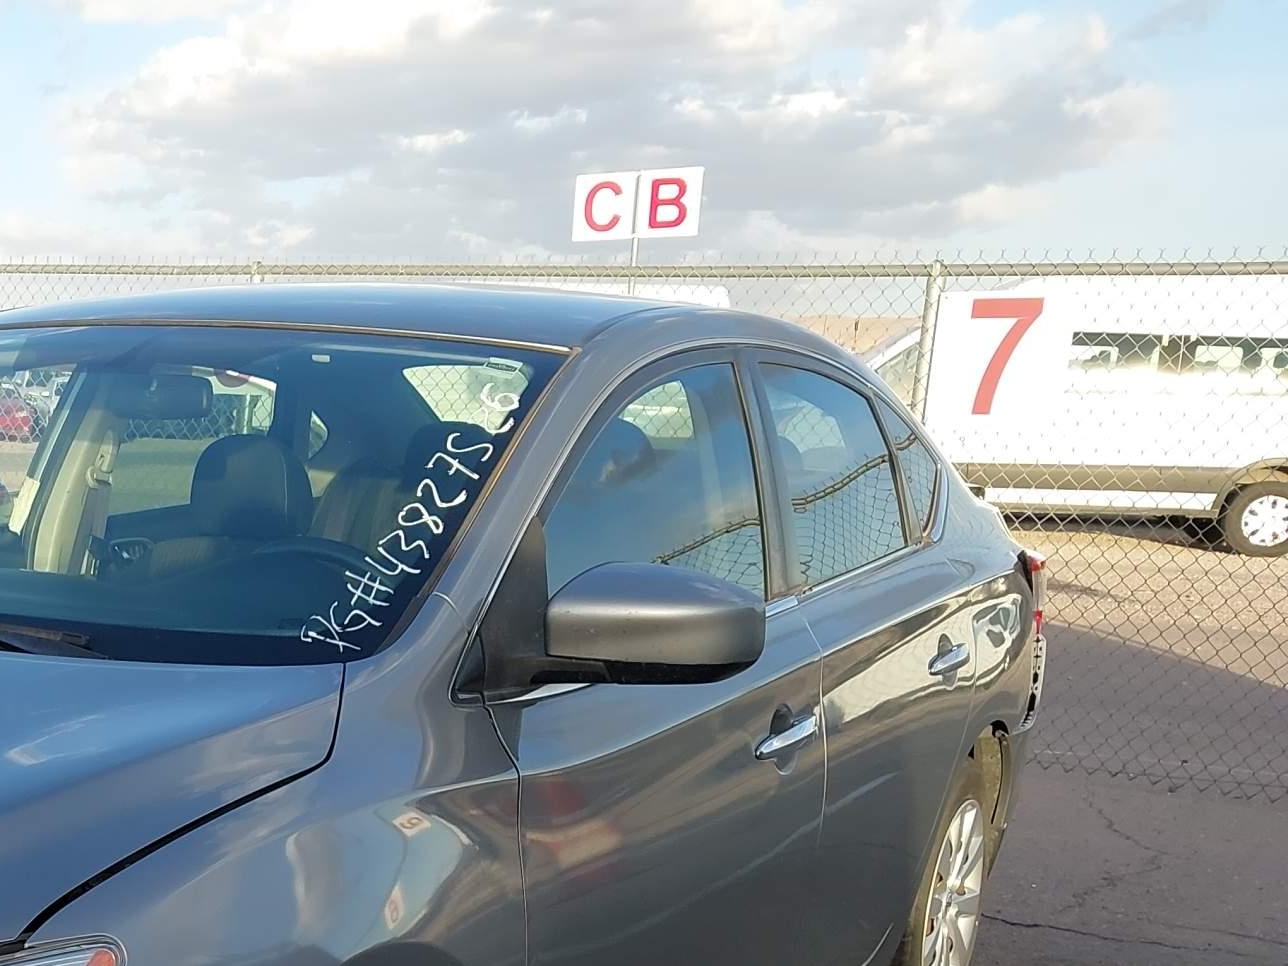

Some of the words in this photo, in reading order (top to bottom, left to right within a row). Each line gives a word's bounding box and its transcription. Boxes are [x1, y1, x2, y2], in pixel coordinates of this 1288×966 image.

[584, 181, 623, 232] C
[648, 178, 688, 229] B
[971, 297, 1045, 415] 7
